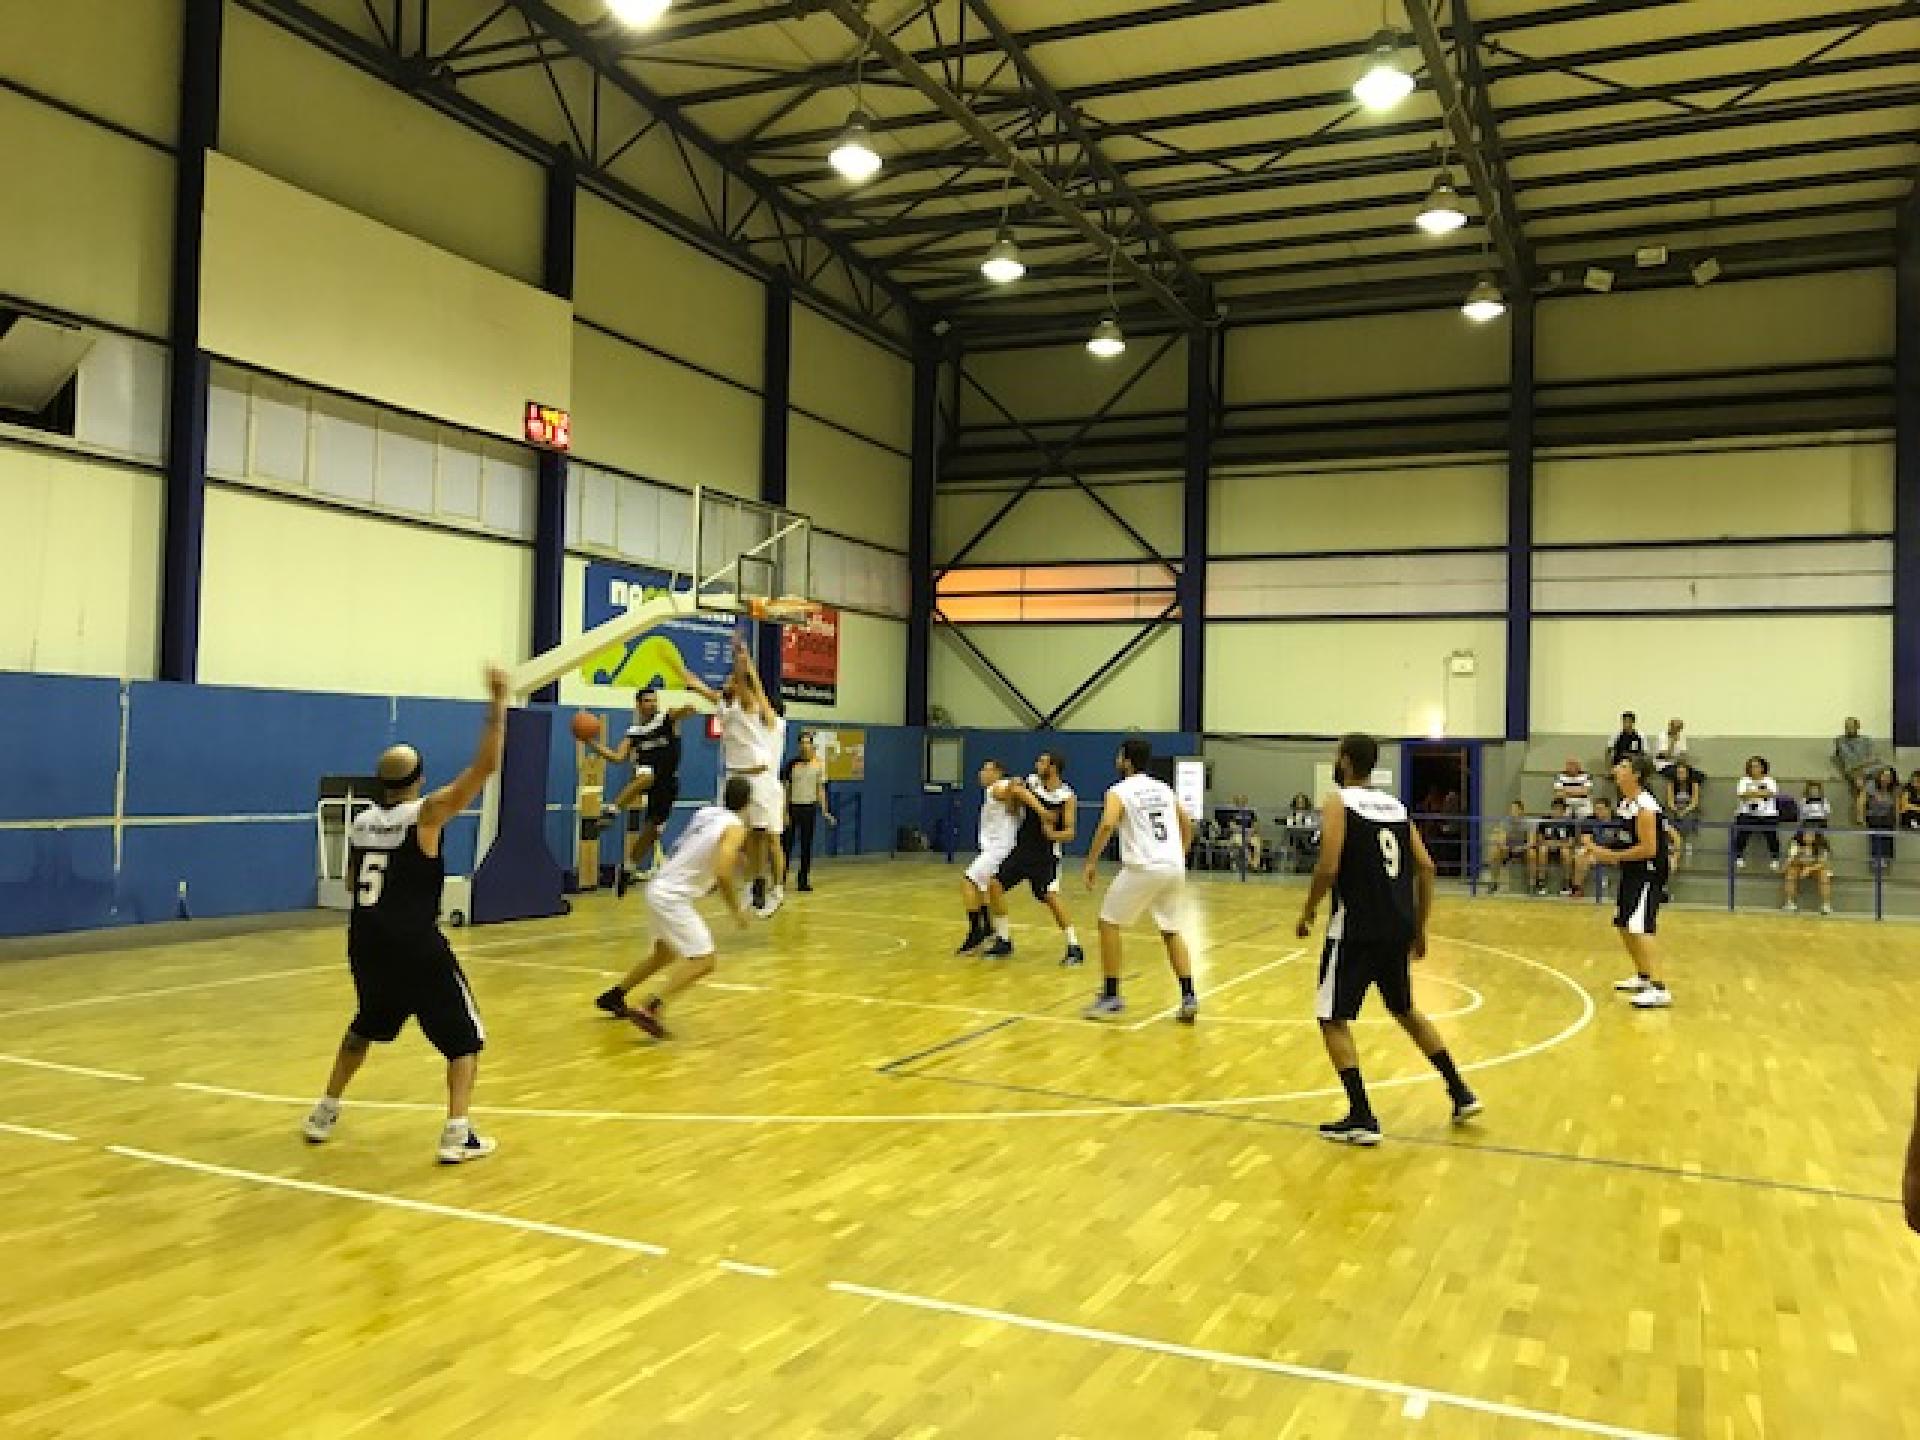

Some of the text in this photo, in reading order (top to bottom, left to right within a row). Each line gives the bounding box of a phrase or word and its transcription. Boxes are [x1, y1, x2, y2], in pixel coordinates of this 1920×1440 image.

[1148, 810, 1168, 841] 5
[1377, 827, 1400, 878] 9
[358, 852, 388, 906] 5
